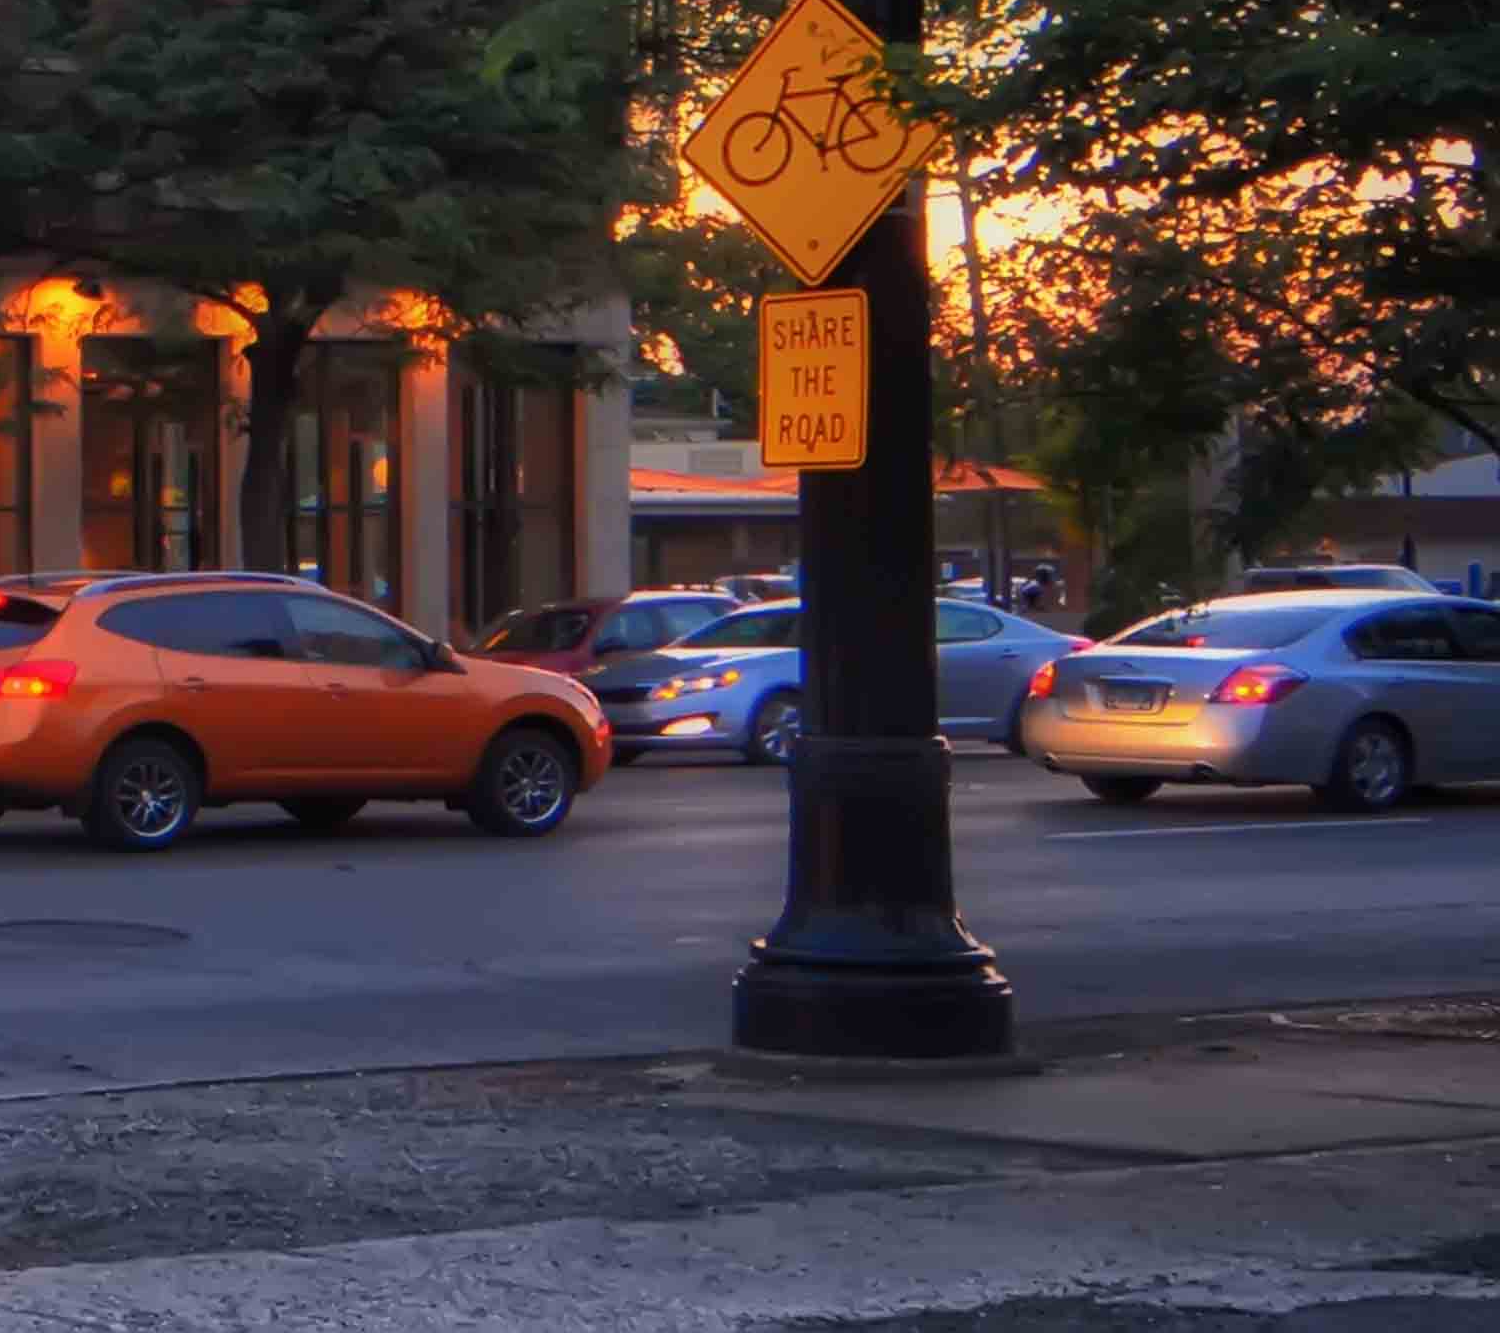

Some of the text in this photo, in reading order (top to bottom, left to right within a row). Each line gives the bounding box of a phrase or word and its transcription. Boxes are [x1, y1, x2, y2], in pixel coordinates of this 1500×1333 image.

[773, 316, 855, 350] SHARE
[791, 365, 837, 397] THE
[779, 413, 845, 445] ROAD
